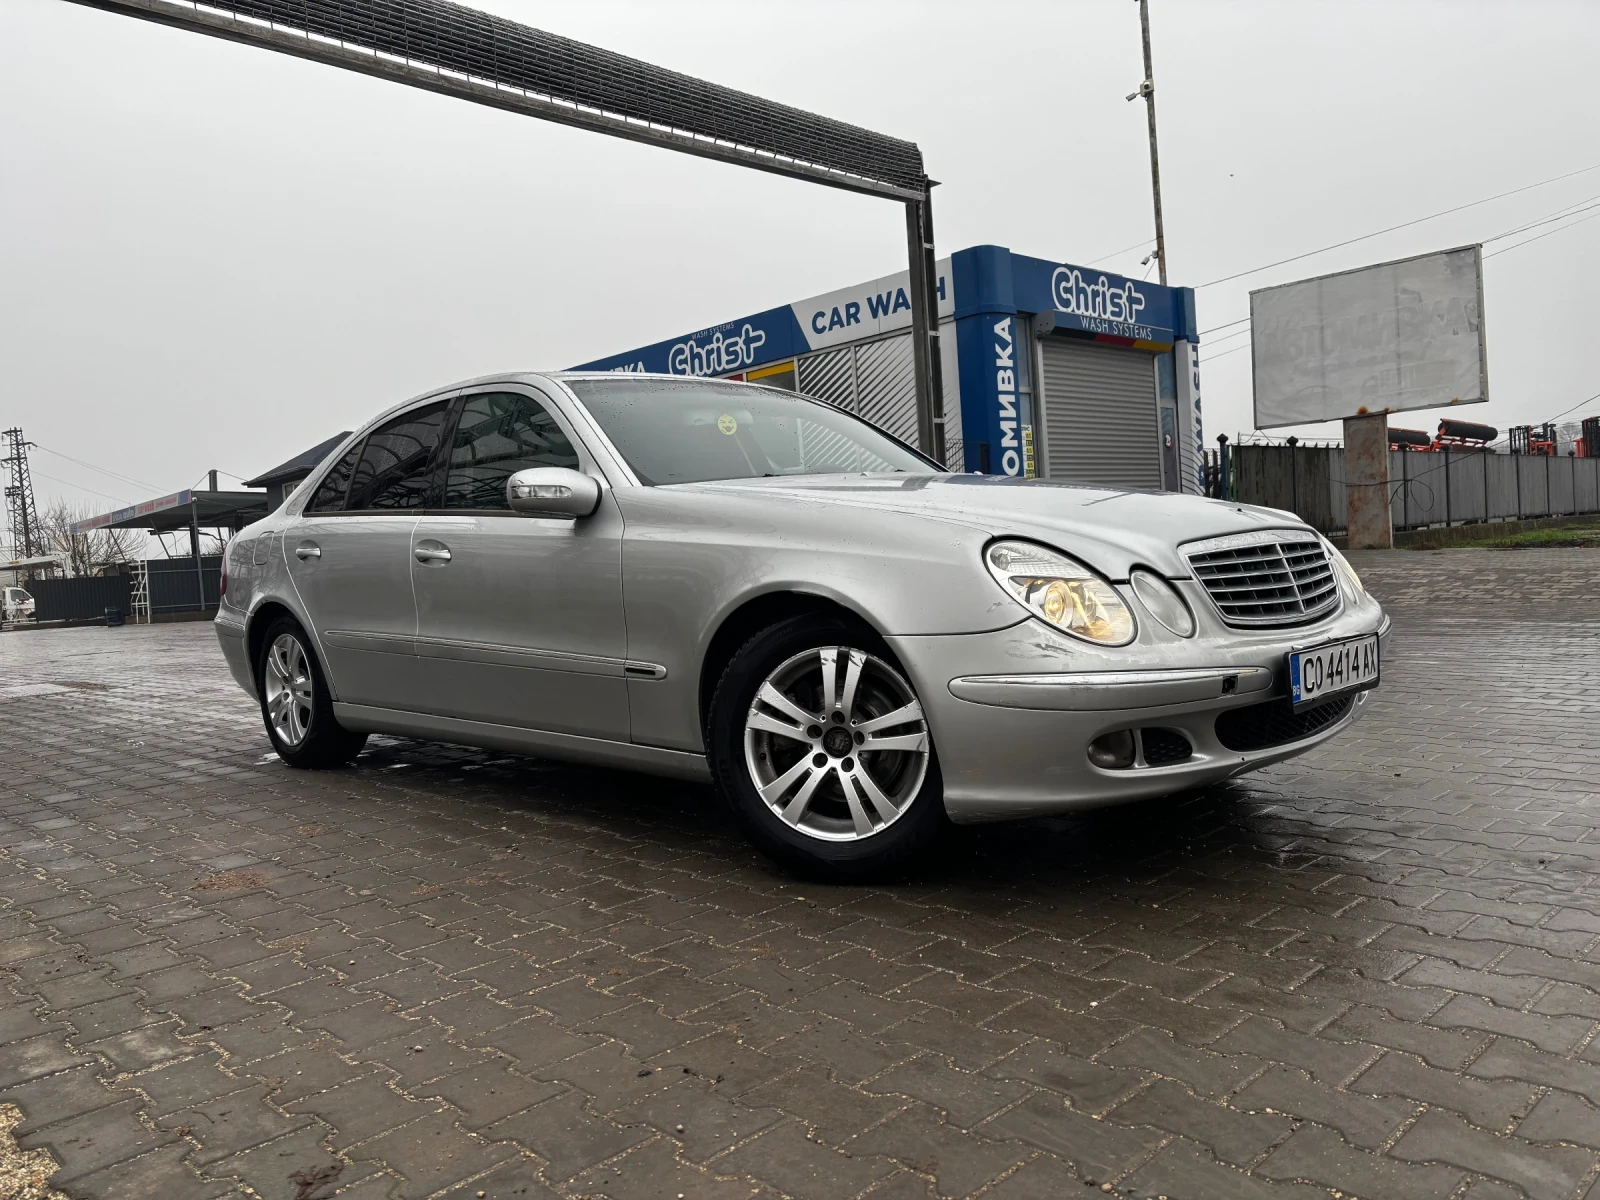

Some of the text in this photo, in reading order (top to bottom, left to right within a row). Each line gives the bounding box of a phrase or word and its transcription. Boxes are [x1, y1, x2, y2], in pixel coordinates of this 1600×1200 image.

[811, 276, 946, 335] CAR WAH
[1051, 266, 1145, 323] Christ
[668, 323, 766, 377] Christ
[691, 321, 735, 340] WASH SYSTEMS
[1080, 316, 1153, 341] WASH SYSTEMS
[1326, 644, 1360, 687] 4414
[1363, 640, 1376, 678] AX
